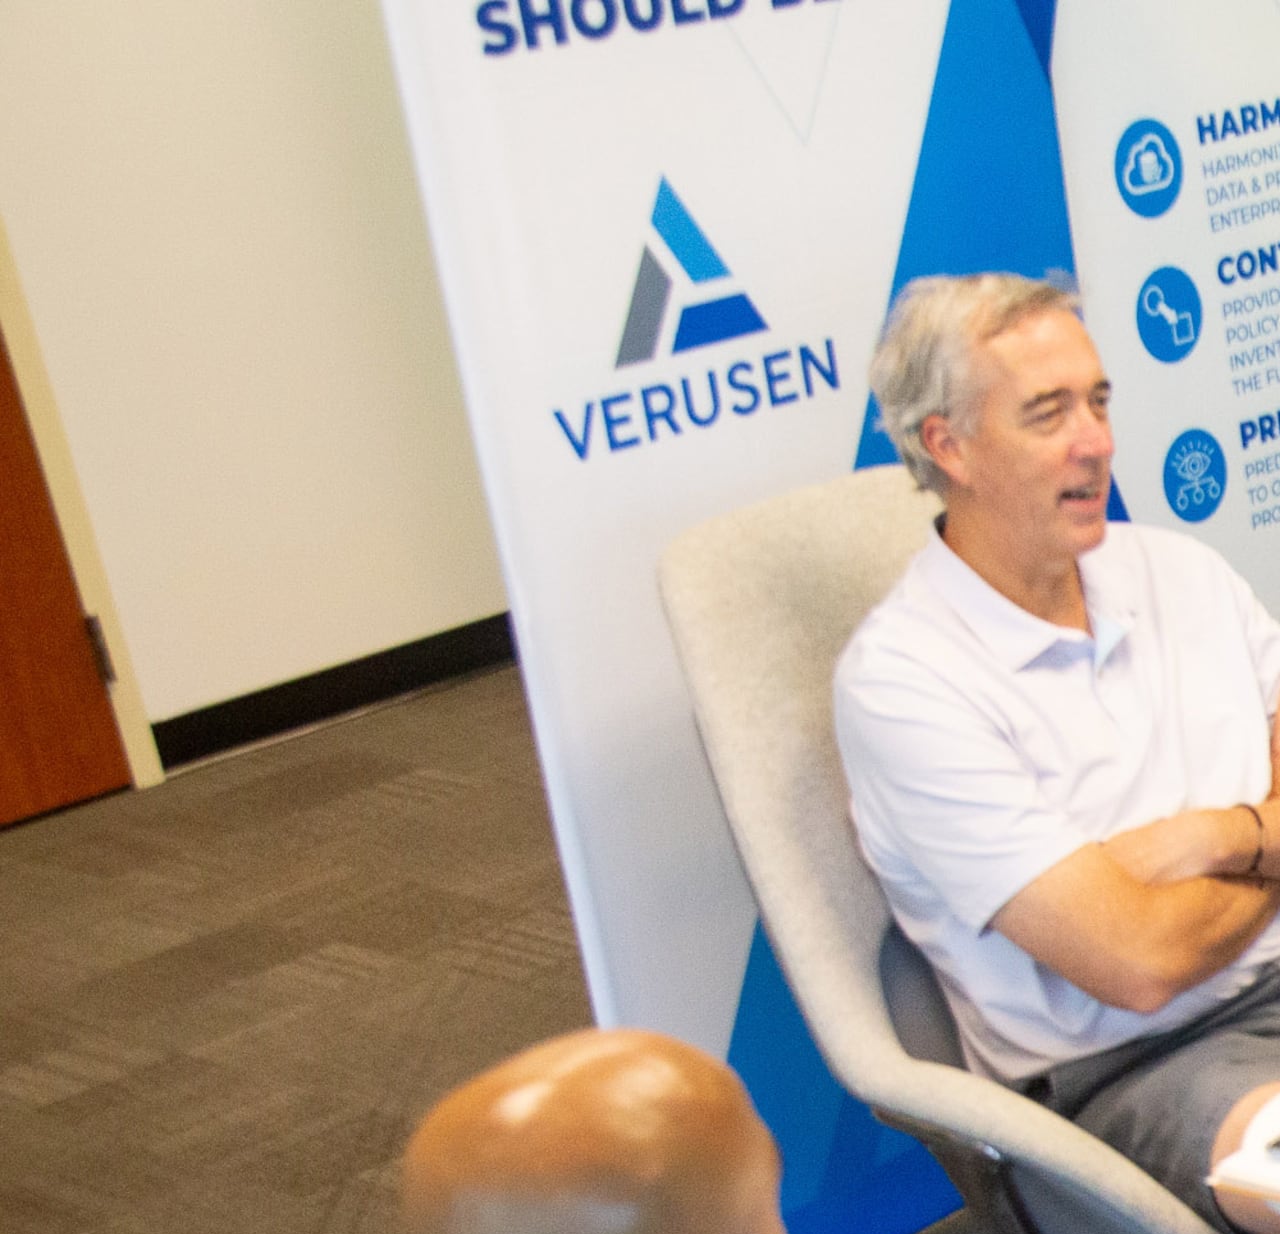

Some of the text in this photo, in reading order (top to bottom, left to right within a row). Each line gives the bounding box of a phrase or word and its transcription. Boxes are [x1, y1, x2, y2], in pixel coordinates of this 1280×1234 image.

[1205, 182, 1248, 207] DATA
[1251, 177, 1262, 195] &
[1226, 315, 1280, 345] POLICY
[552, 336, 841, 461] VERUSEN
[1232, 370, 1263, 397] THE
[1247, 484, 1269, 506] TO
